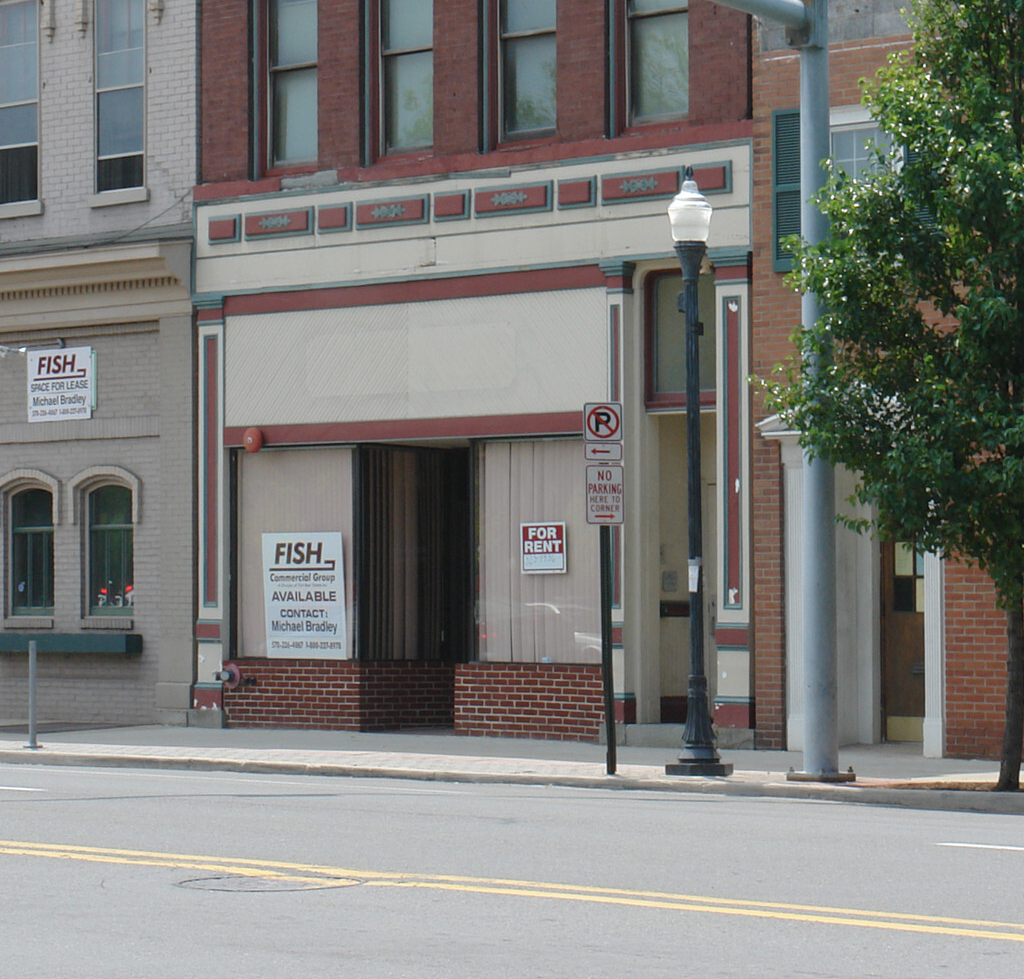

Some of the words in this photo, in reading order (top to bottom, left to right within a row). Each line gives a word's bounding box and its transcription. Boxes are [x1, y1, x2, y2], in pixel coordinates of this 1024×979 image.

[37, 353, 77, 376] FISH
[30, 382, 50, 393] SPACE
[51, 381, 65, 391] FOR
[66, 379, 89, 390] LEASE
[32, 395, 59, 407] Michael
[60, 394, 87, 406] Bradley
[597, 470, 613, 482] NO
[588, 483, 622, 495] PARKING
[590, 495, 609, 504] HERE
[612, 495, 621, 504] TO
[590, 504, 620, 513] CORNER
[527, 527, 557, 540] FOR
[274, 541, 323, 565] FISH
[524, 540, 562, 554] RENT
[269, 572, 312, 583] Commercial
[313, 572, 336, 584] Group
[271, 590, 337, 602] AVAILABLE
[280, 609, 329, 618] CONTACT:
[271, 620, 304, 632] Michael
[305, 620, 338, 635] Bradley
